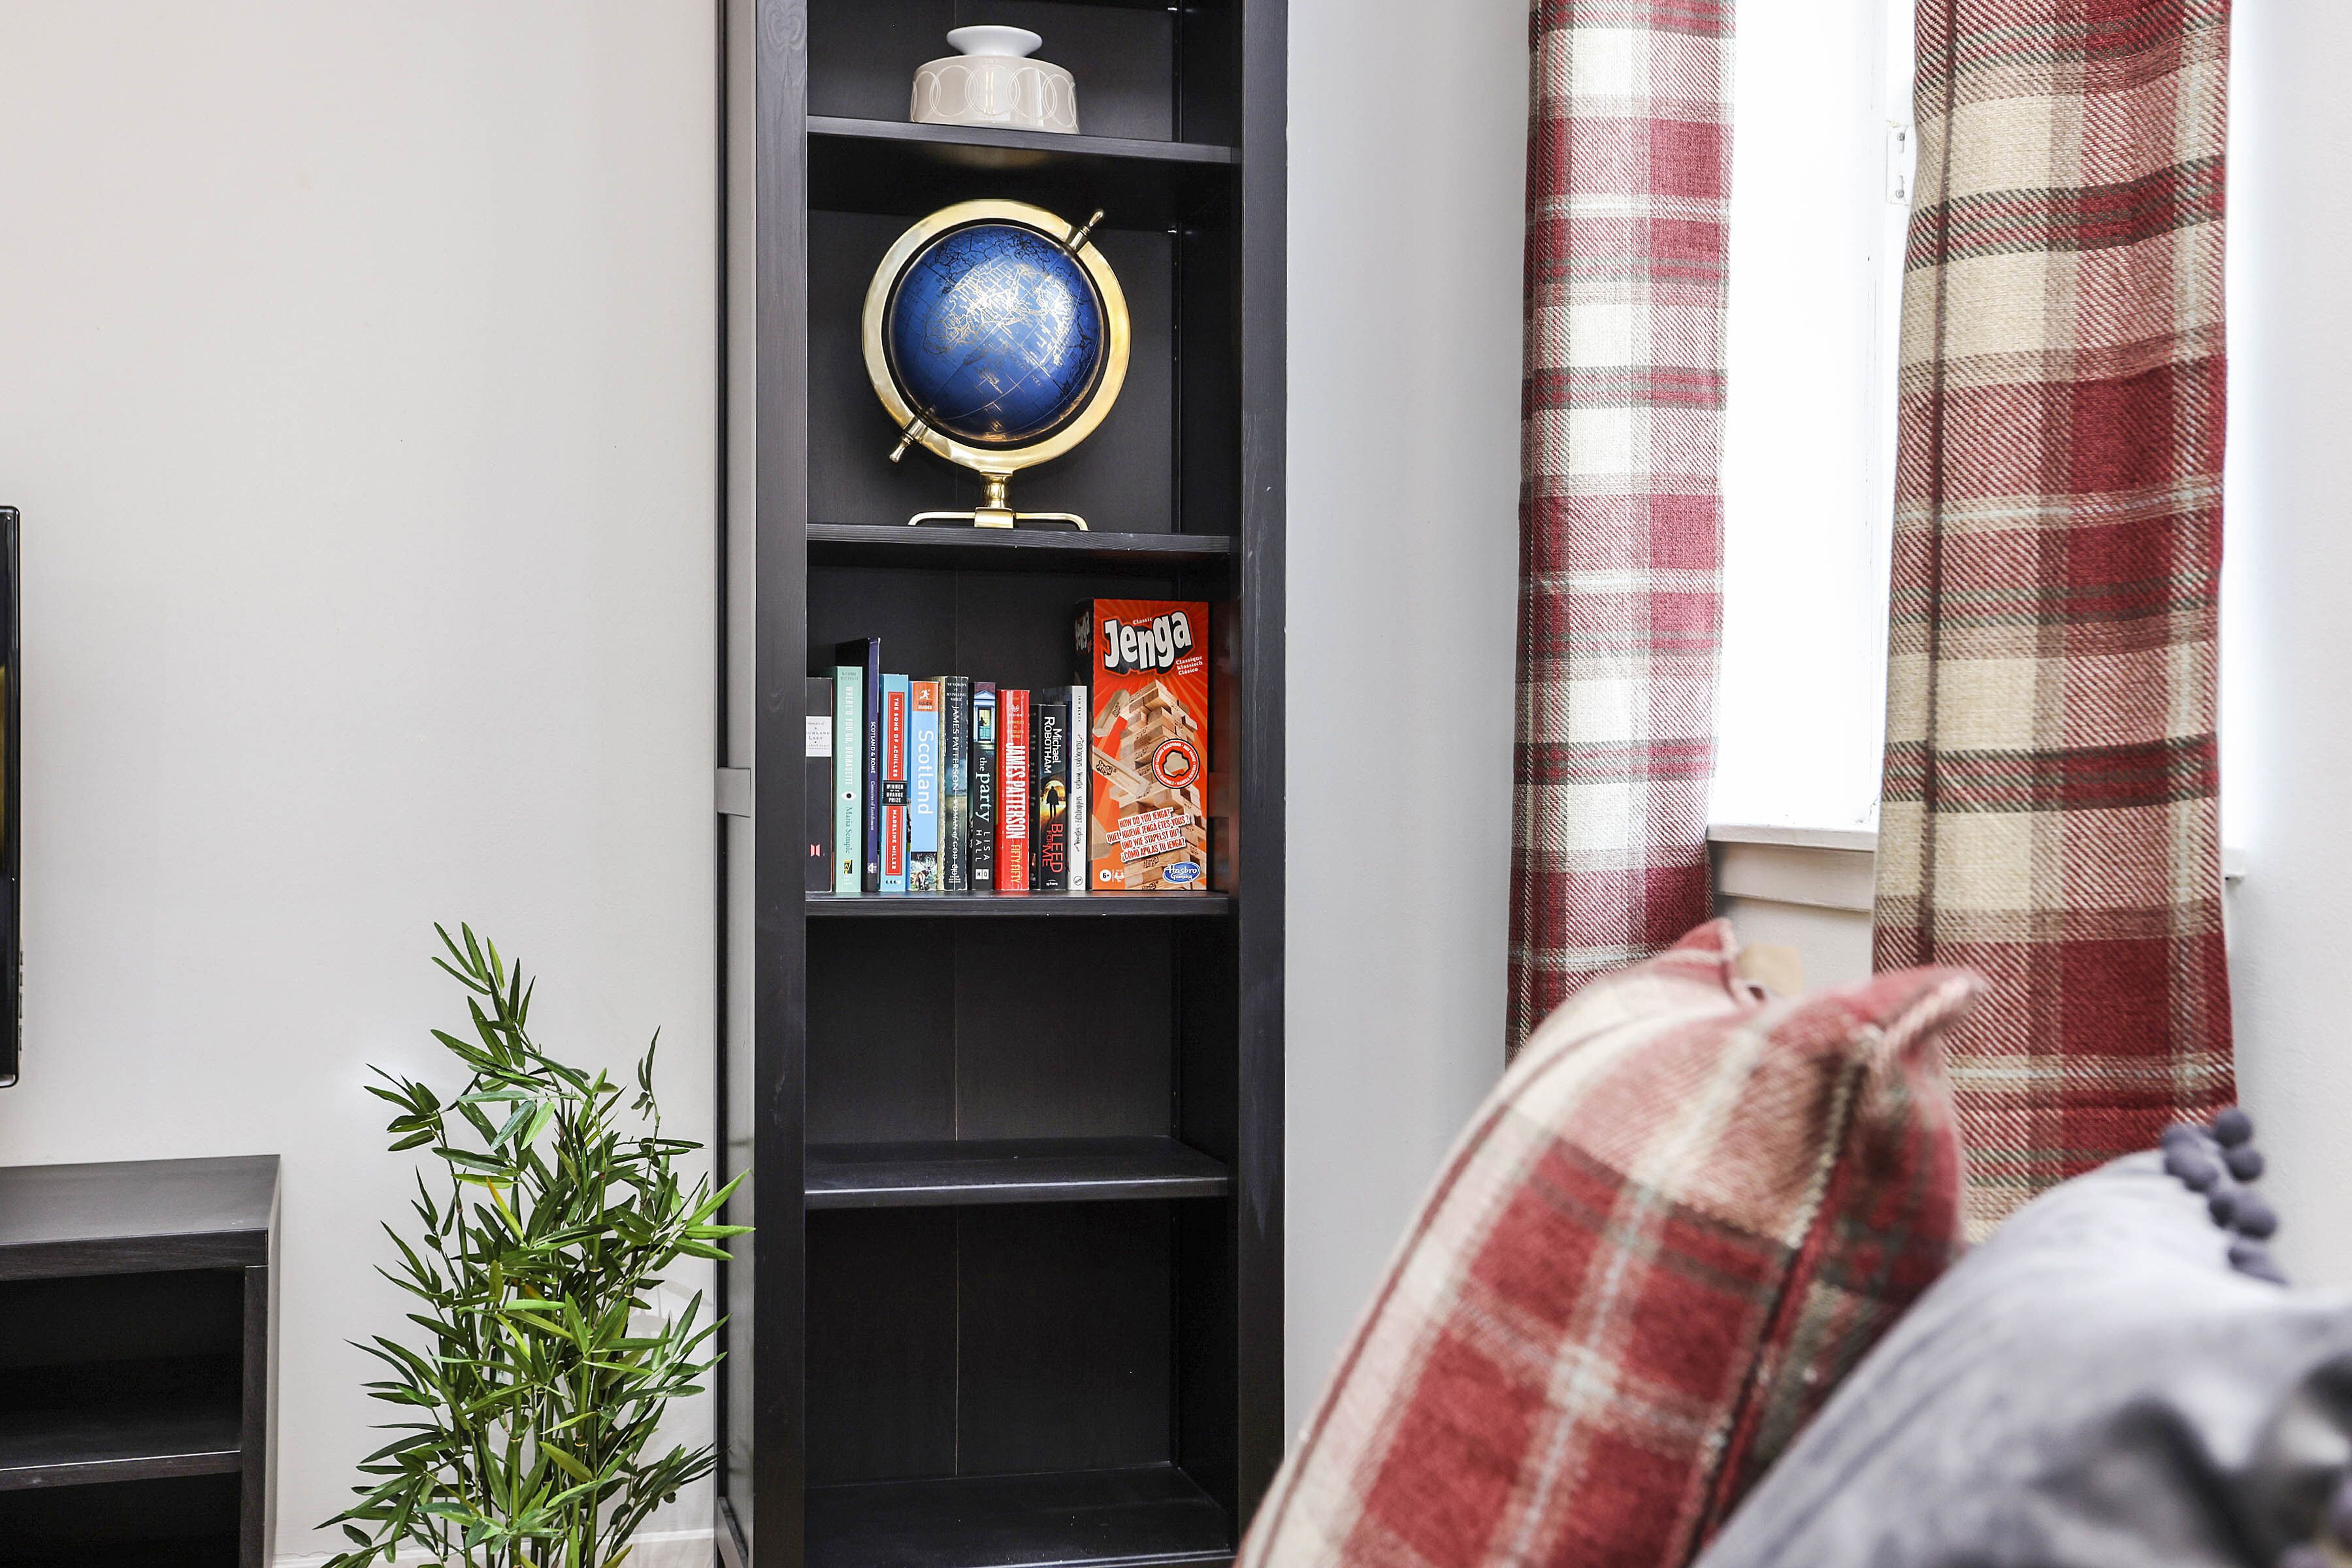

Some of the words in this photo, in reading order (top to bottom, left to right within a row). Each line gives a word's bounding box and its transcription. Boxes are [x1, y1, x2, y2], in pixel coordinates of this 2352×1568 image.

[1132, 617, 1152, 625] Classic
[1104, 612, 1192, 670] Jenga
[1175, 655, 1203, 665] Classique
[1177, 661, 1203, 670] klassisch
[1178, 667, 1198, 676] Clásico
[845, 717, 853, 731] YOU
[951, 706, 960, 734] JAMES
[844, 733, 853, 744] GO,
[893, 734, 898, 743] OF
[1043, 716, 1056, 774] ROBOTHAM
[1052, 728, 1062, 764] Michael
[979, 757, 988, 772] the
[1005, 742, 1025, 778] JAMES
[1096, 760, 1113, 776] Jenga
[917, 730, 934, 815] Scotland
[975, 772, 992, 823] party
[1005, 781, 1026, 839] PATTERSON
[1119, 819, 1132, 828] HOW
[1132, 817, 1140, 825] DO
[1140, 815, 1152, 823] YOU
[843, 829, 853, 854] Semple
[951, 830, 959, 840] of
[1107, 833, 1120, 842] QUEL
[1120, 828, 1141, 840] JOUEUR
[1141, 824, 1158, 834] JENGA
[1122, 841, 1133, 850] UND
[1133, 838, 1143, 846] WIE
[1143, 831, 1169, 844] STAPELST
[1169, 828, 1180, 837] DU?
[1010, 844, 1021, 863] FIFTY
[1042, 845, 1051, 868] ME
[1051, 823, 1064, 873] BLEED
[1139, 845, 1159, 857] APILAS
[1166, 838, 1185, 849] JENGA?
[1010, 864, 1021, 883] FIFTY
[1165, 864, 1198, 876] Hasbro
